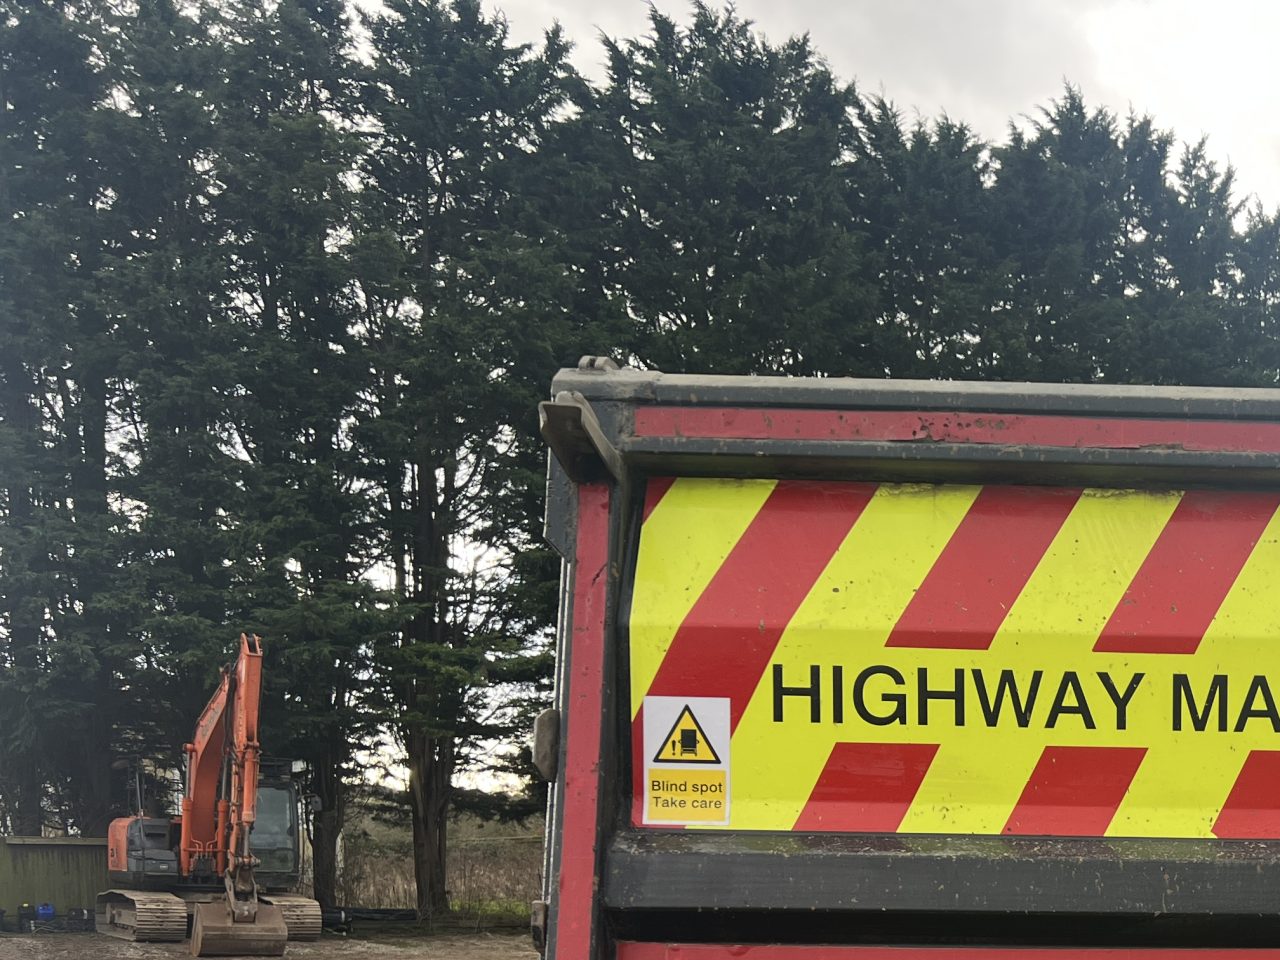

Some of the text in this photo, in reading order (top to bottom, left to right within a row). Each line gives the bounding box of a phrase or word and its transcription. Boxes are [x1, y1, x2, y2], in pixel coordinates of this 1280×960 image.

[772, 663, 1146, 730] HIGHWAY
[651, 780, 723, 795] Blind spot
[652, 796, 723, 809] Take care
